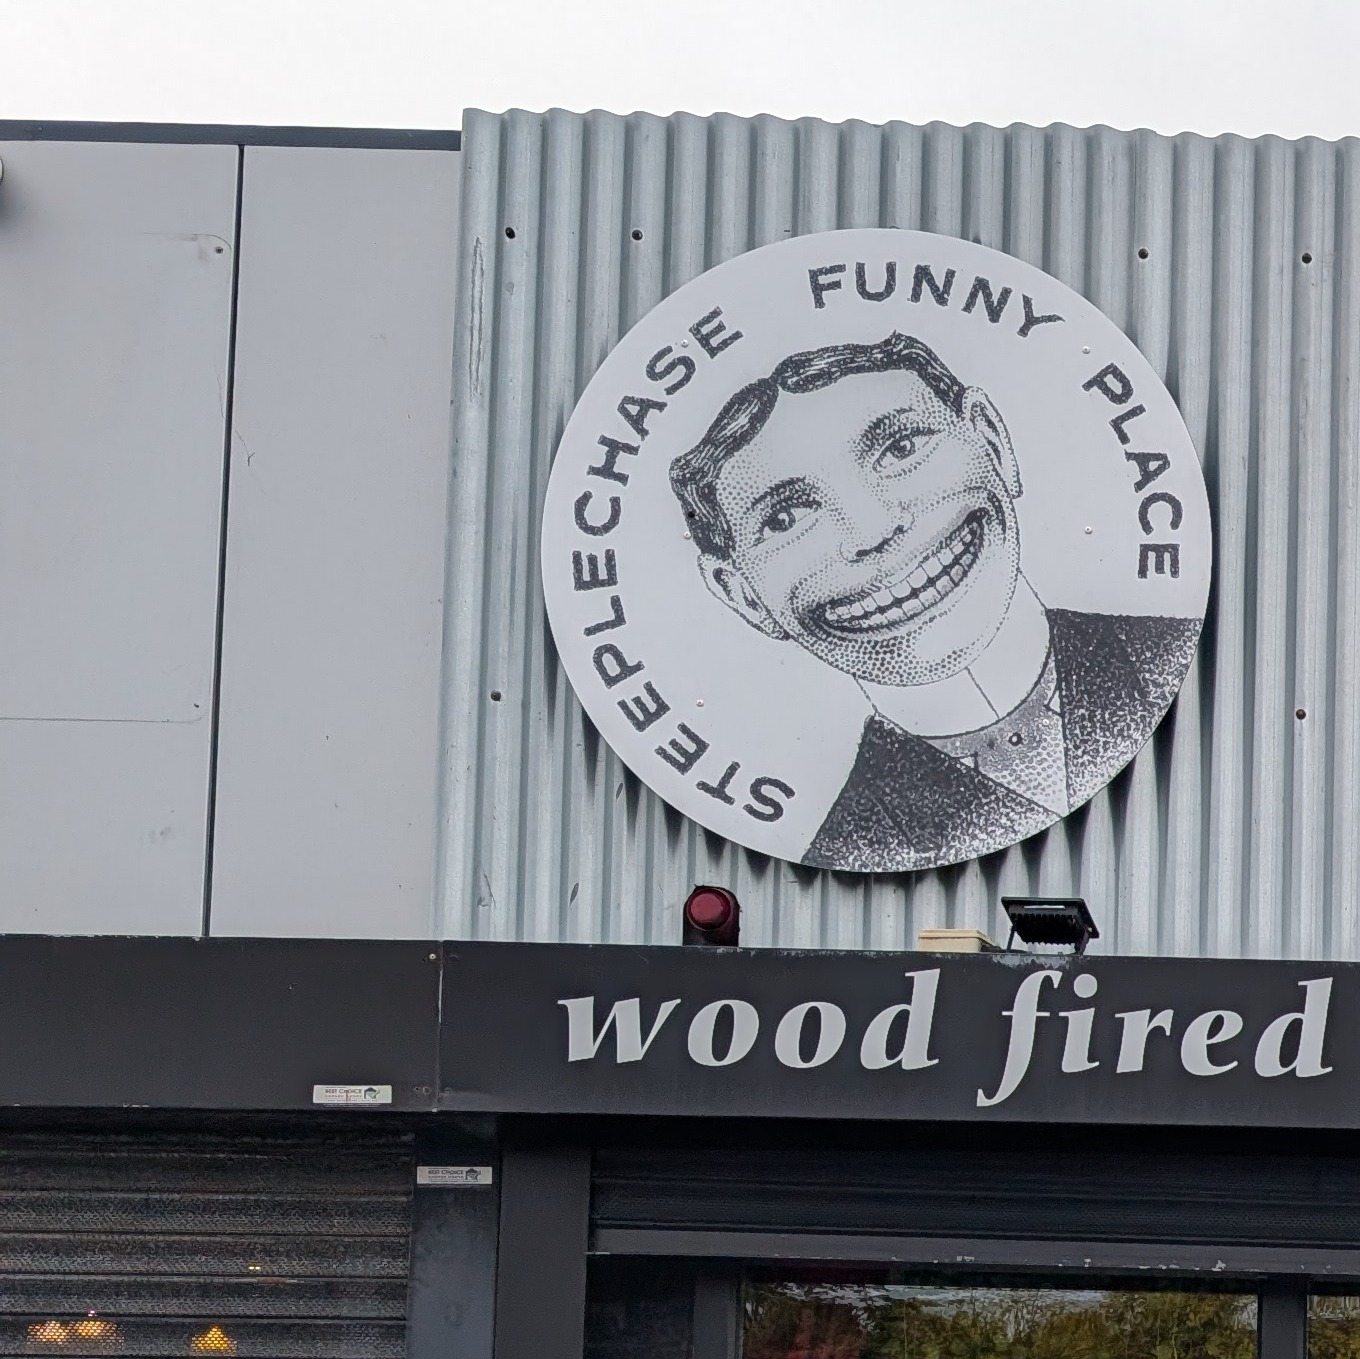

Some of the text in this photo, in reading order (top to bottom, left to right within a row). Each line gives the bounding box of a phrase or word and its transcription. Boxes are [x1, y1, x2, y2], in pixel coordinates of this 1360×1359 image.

[573, 262, 1184, 822] STEEPLECHASE FUNNY PLACE
[560, 968, 942, 1071] wood
[976, 970, 1336, 1108] fired
